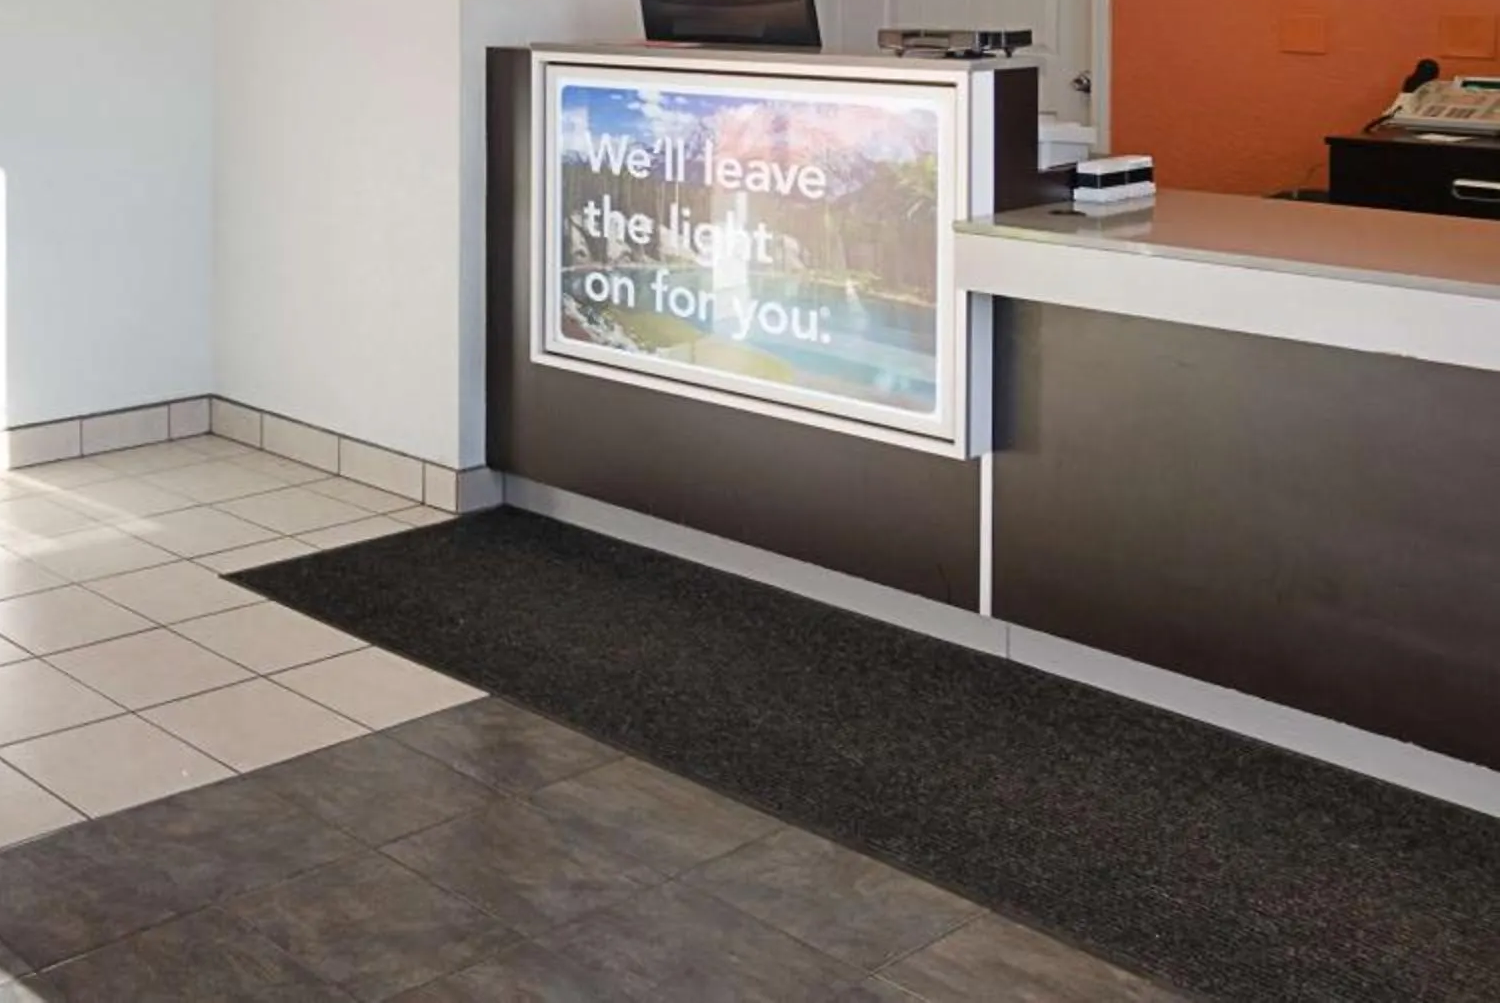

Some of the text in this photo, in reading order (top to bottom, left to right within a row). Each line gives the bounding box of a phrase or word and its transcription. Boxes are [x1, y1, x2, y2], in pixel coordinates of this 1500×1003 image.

[584, 130, 827, 200] We'll leave
[583, 193, 774, 269] the light
[584, 270, 635, 308] on
[651, 268, 717, 322] for
